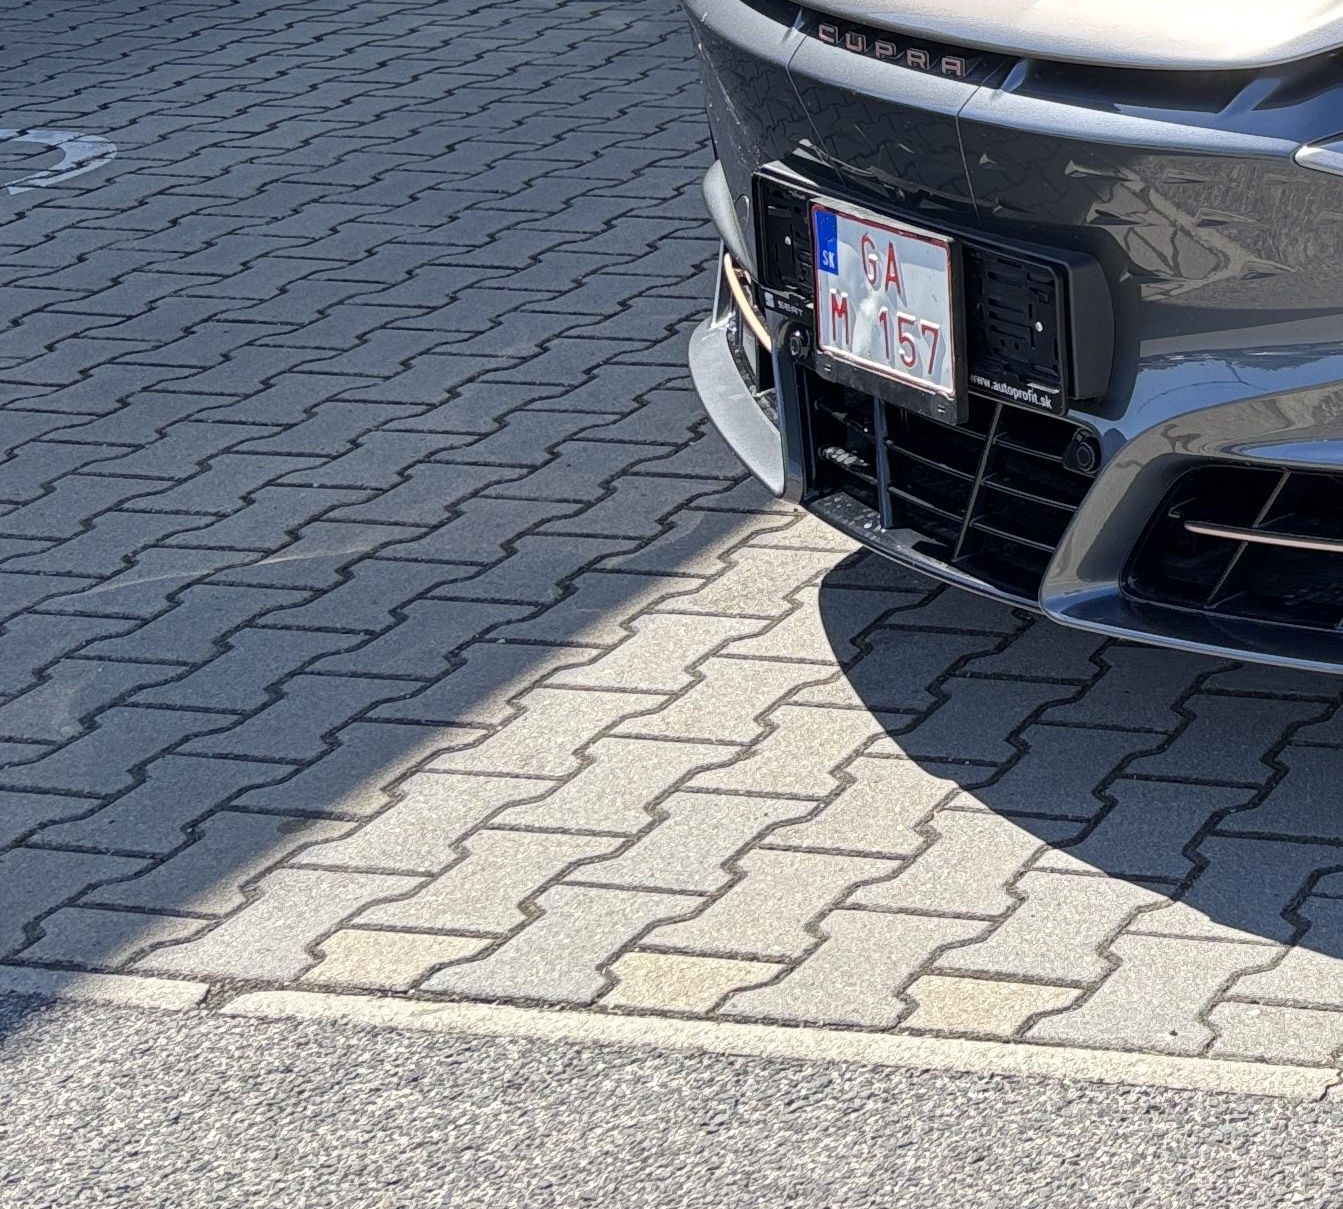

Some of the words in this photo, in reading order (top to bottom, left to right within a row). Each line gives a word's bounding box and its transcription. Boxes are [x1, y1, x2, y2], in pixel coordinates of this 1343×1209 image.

[818, 22, 966, 78] CUPRA
[821, 249, 836, 270] SK
[860, 233, 901, 297] GA
[829, 289, 850, 346] M
[877, 307, 940, 376] 157
[970, 374, 1052, 409] www.autoprofit.sk
